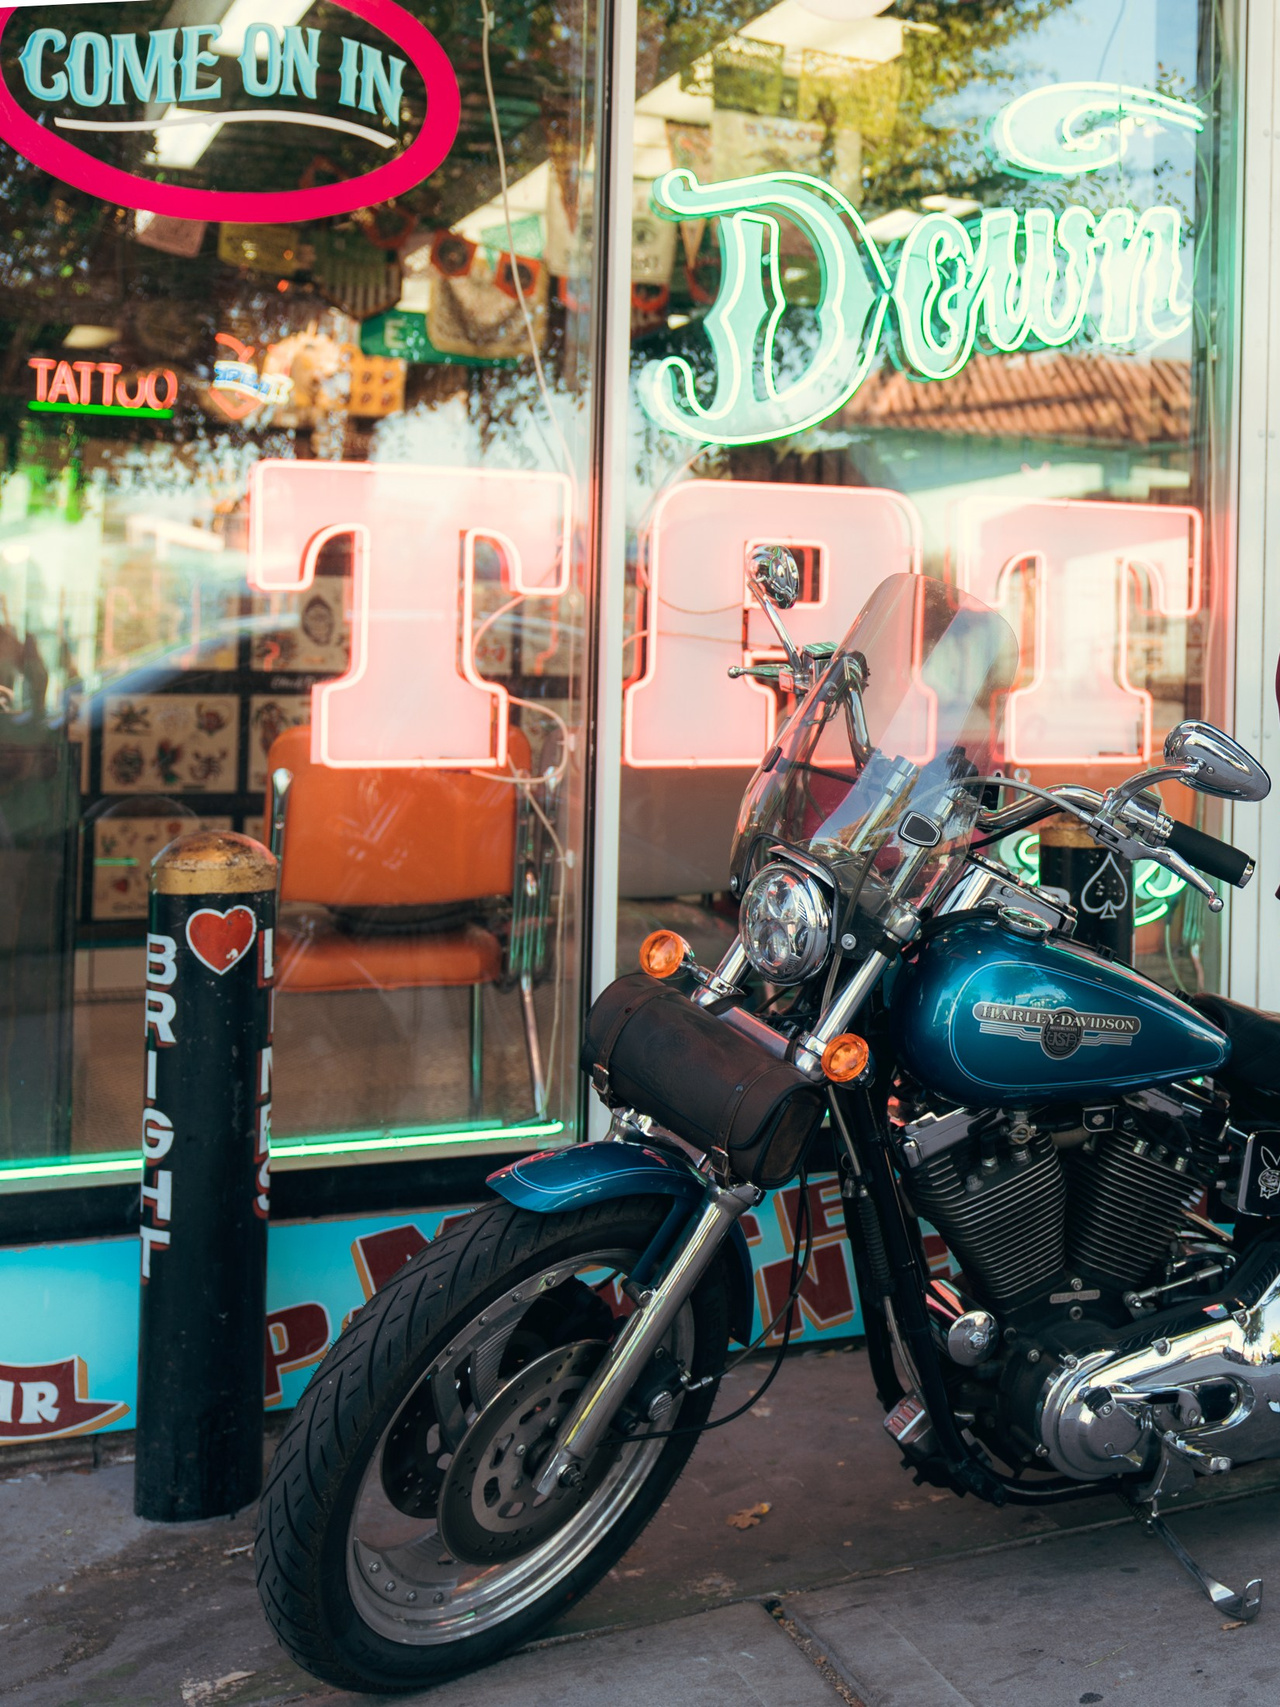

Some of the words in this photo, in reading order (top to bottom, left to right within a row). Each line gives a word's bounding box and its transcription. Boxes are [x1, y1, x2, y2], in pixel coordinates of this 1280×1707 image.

[18, 24, 222, 108] COME
[237, 22, 320, 99] ON
[339, 36, 406, 127] IN
[638, 165, 1196, 446] Down
[140, 932, 178, 1280] BRIGHT
